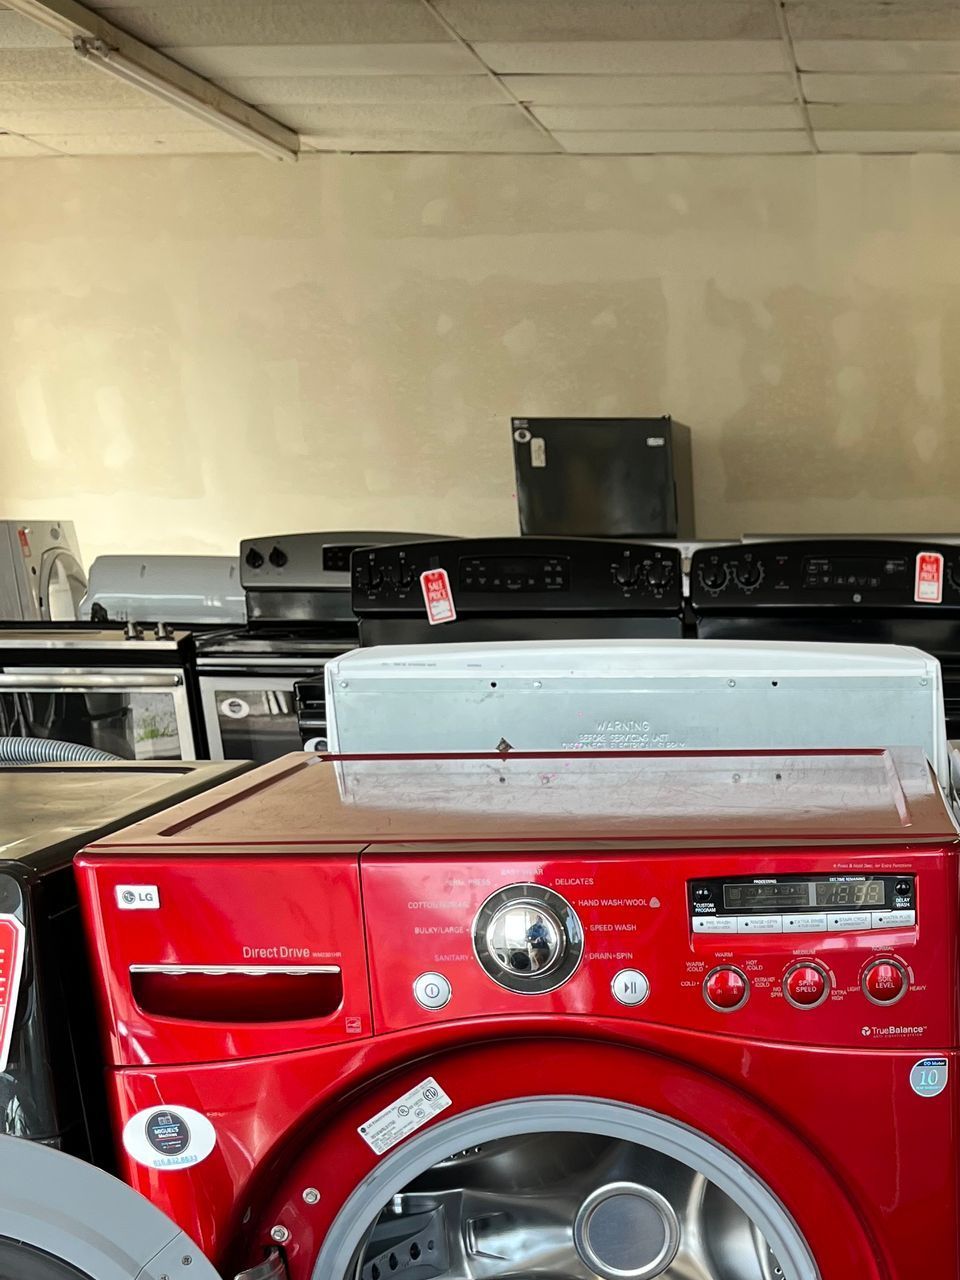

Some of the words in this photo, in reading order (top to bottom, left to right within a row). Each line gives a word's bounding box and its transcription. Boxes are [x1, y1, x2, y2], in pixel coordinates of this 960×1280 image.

[597, 720, 650, 732] WARNING
[555, 878, 594, 886] DELICATES
[139, 893, 153, 902] LG
[578, 899, 600, 907] HAND
[601, 899, 648, 907] WASH/WOOL
[414, 926, 465, 935] BULKY/LARGE
[590, 924, 613, 932] SPEED
[614, 924, 637, 932] WASH
[243, 946, 278, 958] Direct
[280, 946, 310, 958] Drive
[589, 952, 633, 960] DRAIN+SPIN
[920, 1069, 938, 1085] 10
[154, 1126, 179, 1135] MIGUEL'S
